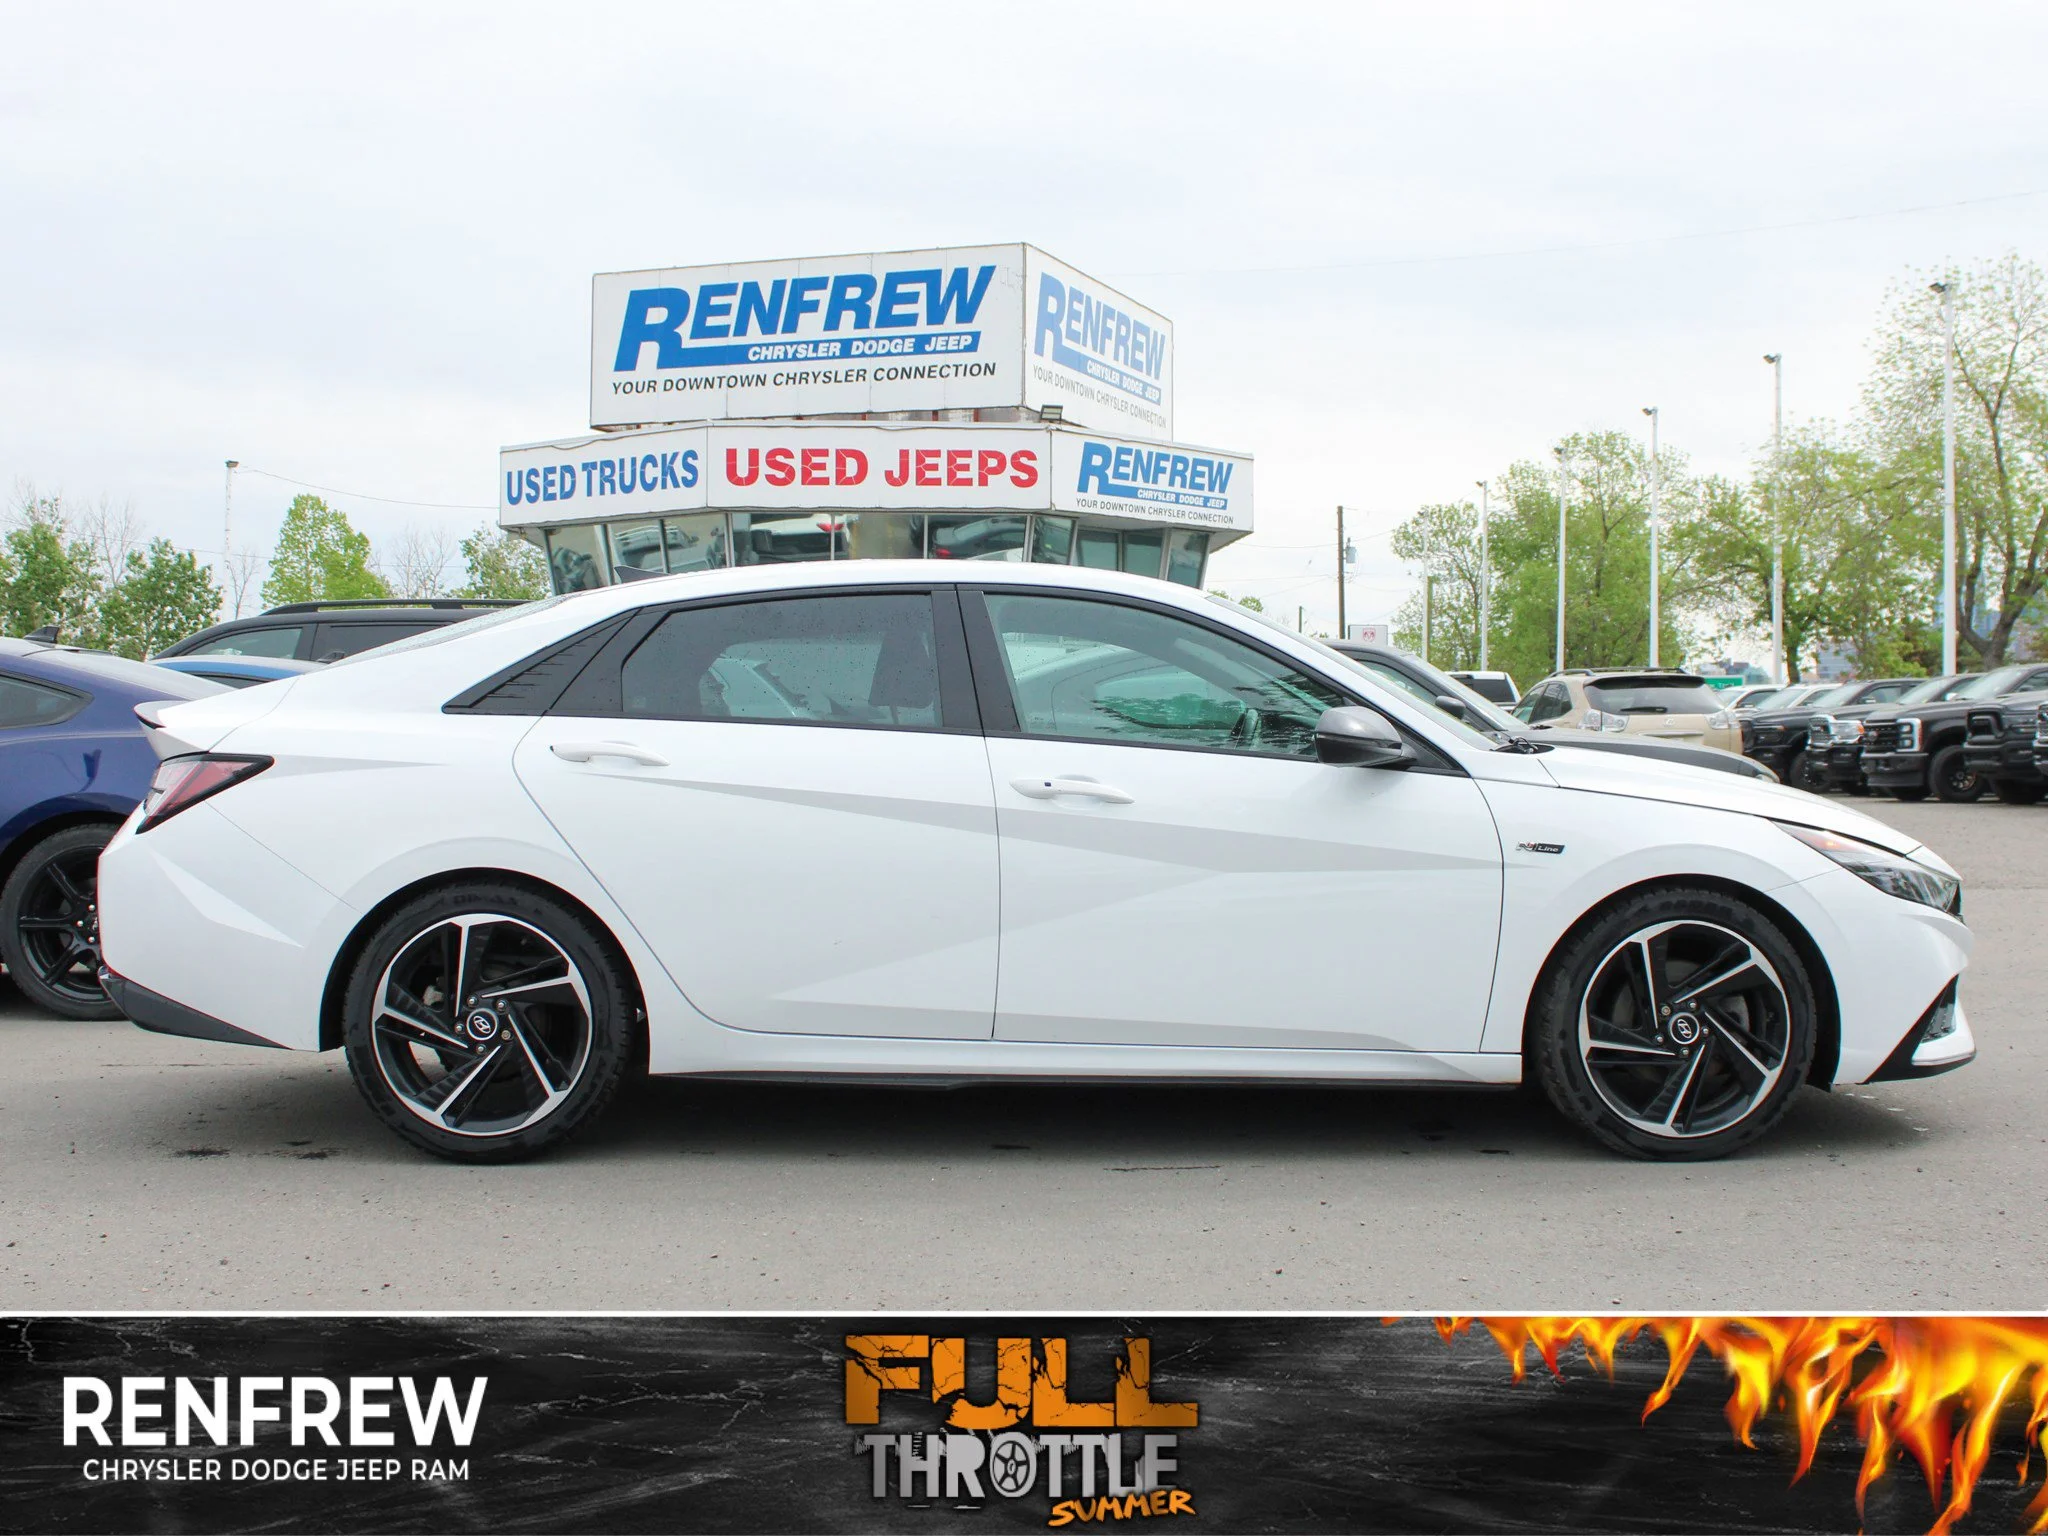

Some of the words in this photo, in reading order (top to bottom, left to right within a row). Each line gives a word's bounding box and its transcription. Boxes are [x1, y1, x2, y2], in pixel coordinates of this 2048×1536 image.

[614, 265, 996, 372] RENFREW
[1034, 272, 1166, 381] RENFREW
[748, 342, 841, 361] CHRYSLER
[851, 338, 915, 356] DODGE
[925, 335, 973, 351] JEEP
[613, 380, 657, 395] YOUR
[663, 374, 767, 391] DOWNTOWN
[773, 368, 867, 386] CHRYSLER
[874, 362, 996, 381] CONNECTION
[1033, 364, 1054, 385] YOUR
[1054, 374, 1095, 400] DOWNTOWN
[1096, 393, 1129, 413] CHRYSLER
[1130, 404, 1167, 429] CONNECTION
[1087, 360, 1120, 385] CHRYSLER
[1123, 376, 1143, 395] DODGE
[1145, 384, 1160, 402] JEEP
[507, 464, 576, 506] USED
[581, 449, 699, 498] TRUCKS
[726, 447, 868, 486] USED
[884, 449, 1038, 488] JEEPS
[1077, 441, 1234, 494] RENFREW
[1076, 498, 1098, 509] YOUR
[1100, 501, 1146, 514] DOWNTOWN
[1147, 506, 1186, 519] CHRYSLER
[1187, 511, 1234, 525] CONNECTION
[1137, 488, 1176, 502] CHRYSLER
[1179, 494, 1204, 506] DODGE
[1206, 497, 1225, 509] JEEP
[1537, 845, 1559, 853] Line
